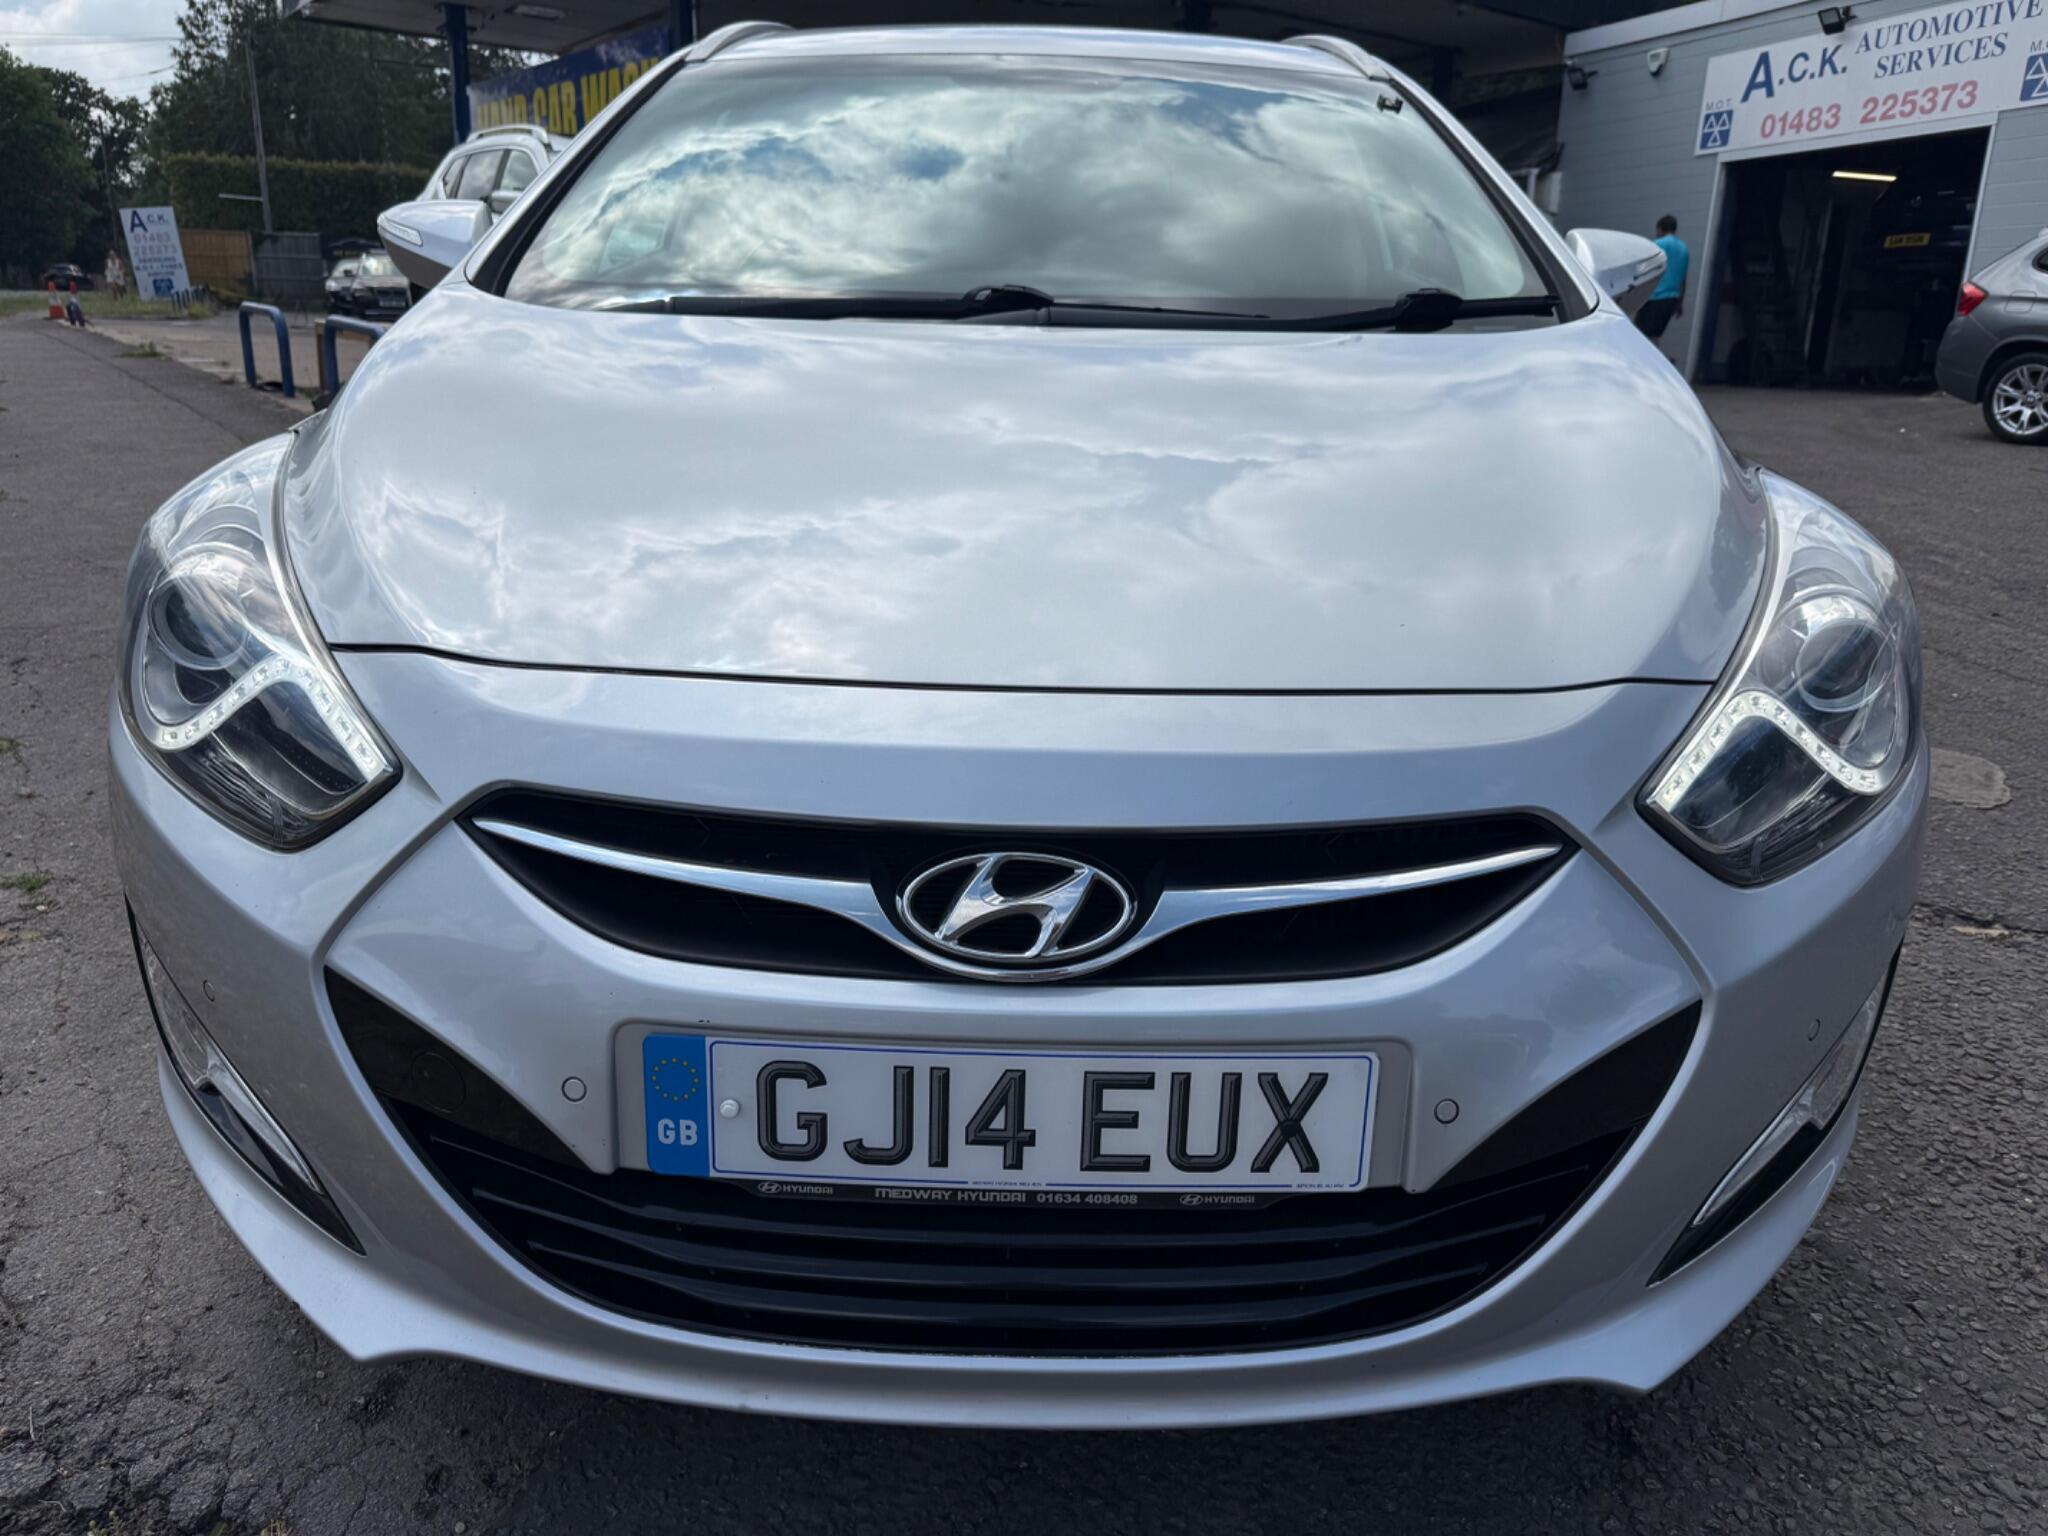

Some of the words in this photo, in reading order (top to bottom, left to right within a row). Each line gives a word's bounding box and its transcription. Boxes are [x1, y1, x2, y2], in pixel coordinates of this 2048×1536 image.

[1855, 0, 2043, 54] AUTOMOTIVE
[1873, 32, 2009, 79] SERVICES
[533, 80, 577, 134] CAR
[1759, 103, 1842, 139] 01483
[1859, 80, 1979, 124] 225373
[657, 1118, 699, 1147] GB
[756, 1060, 1036, 1171] GJ14
[1080, 1071, 1329, 1172] EUX
[782, 1185, 834, 1195] HYUNDAI
[874, 1187, 952, 1200] MEDWAY
[957, 1191, 1026, 1203] HYUNDAI
[1036, 1192, 1081, 1204] 01634
[1203, 1195, 1255, 1205] HYUNDAI
